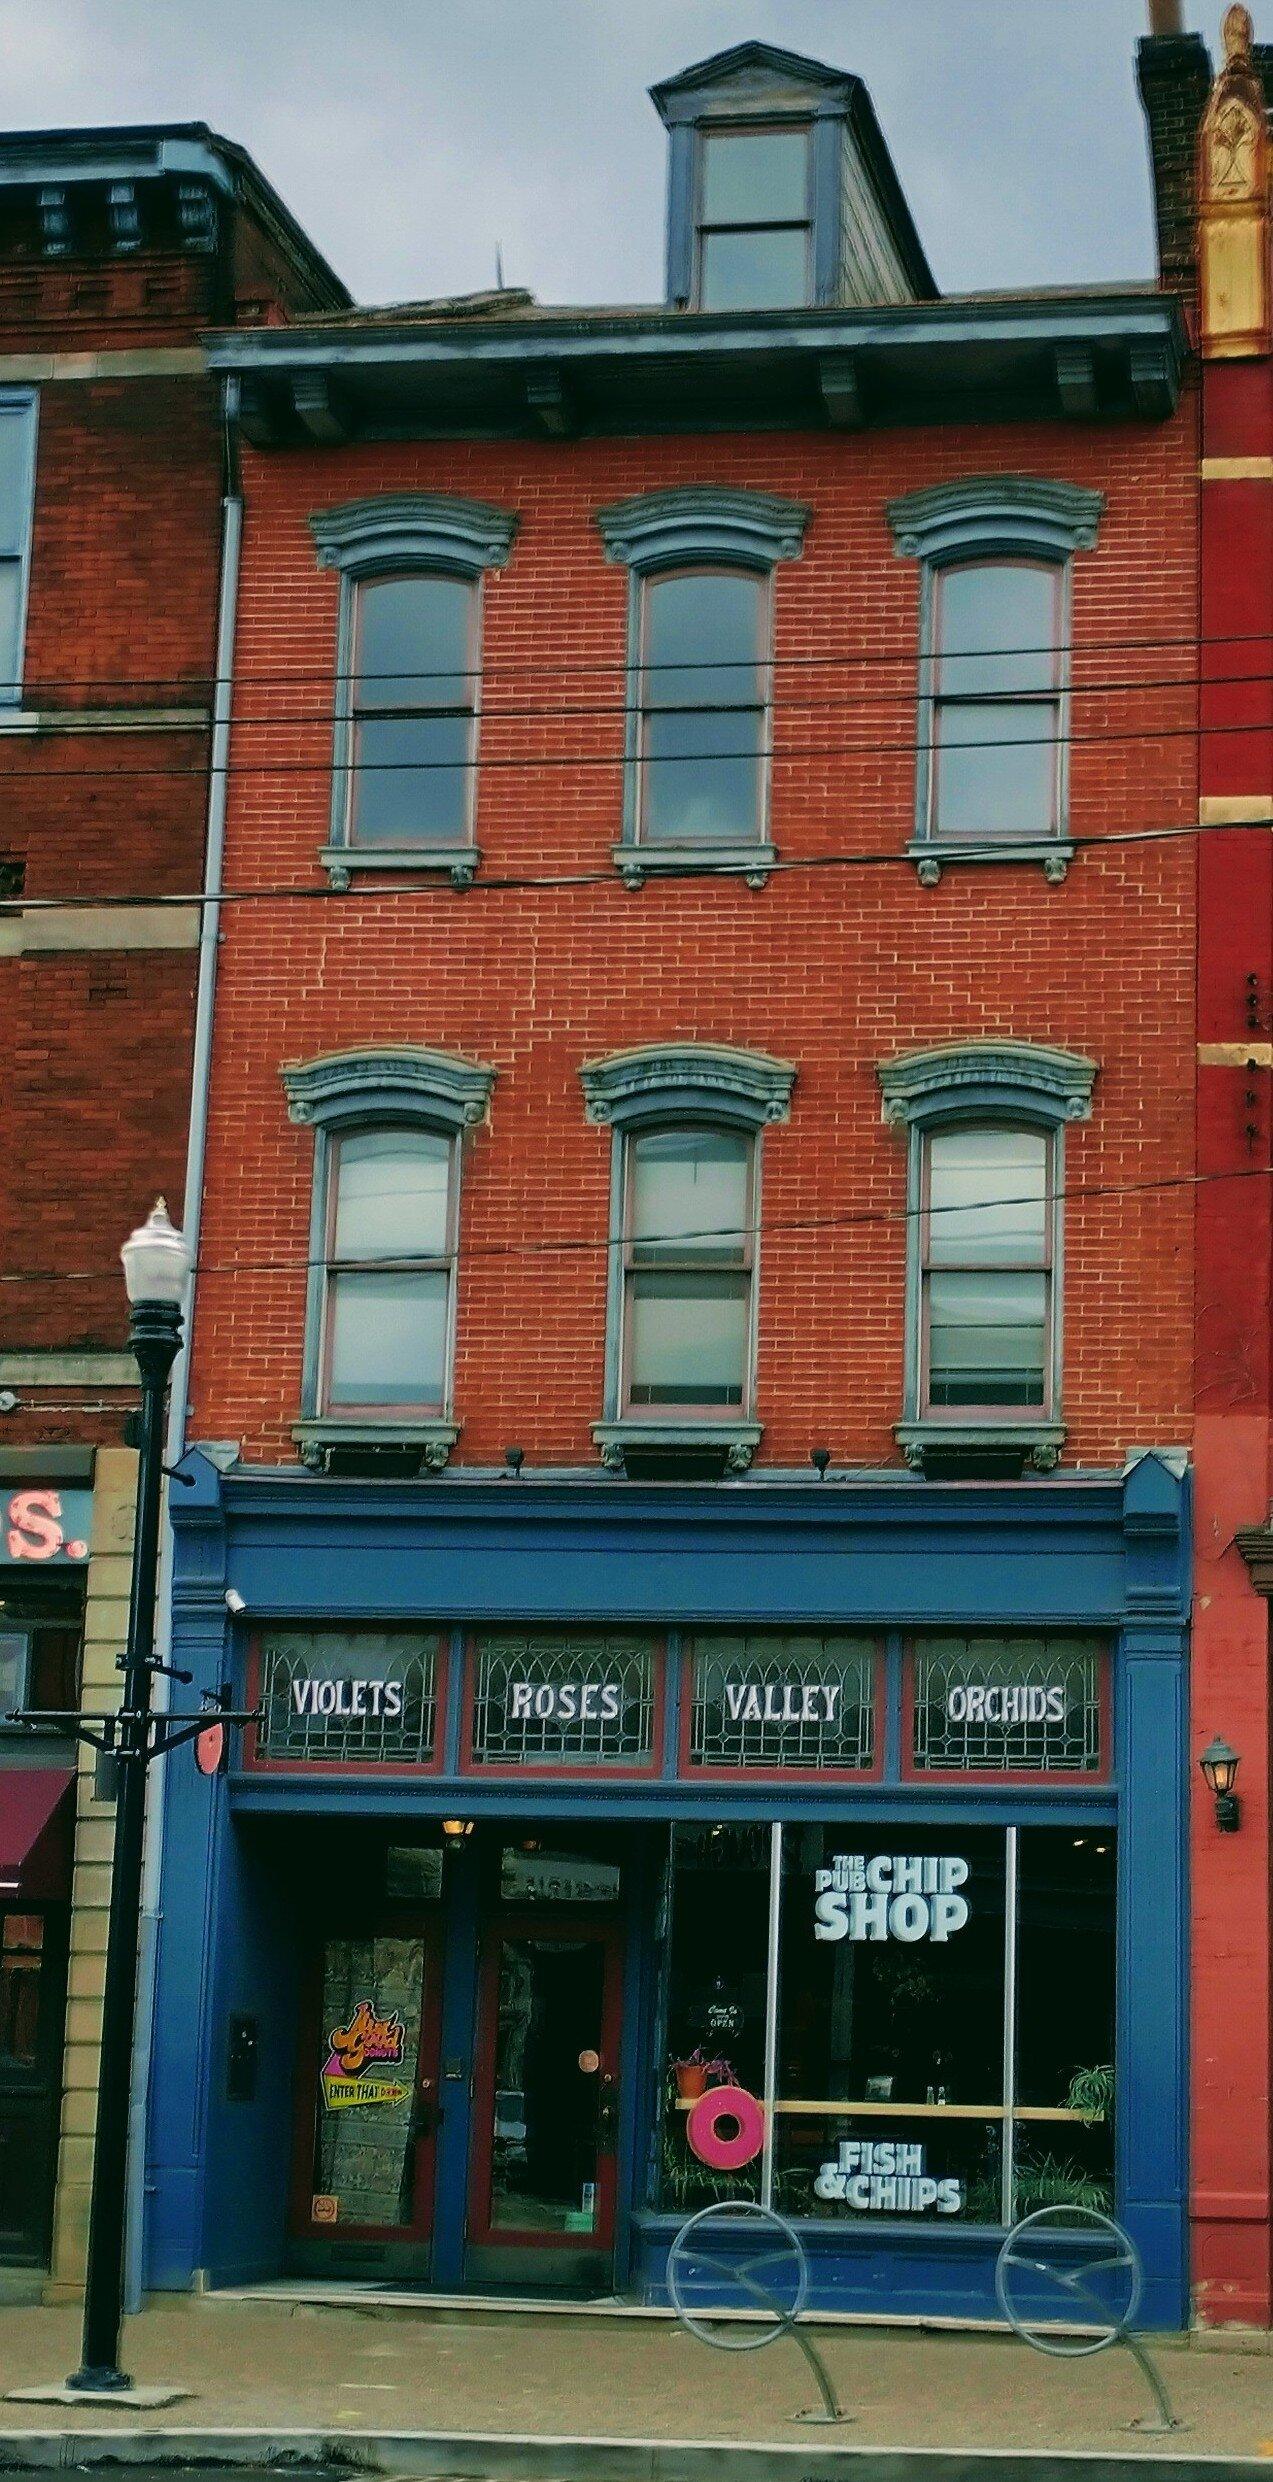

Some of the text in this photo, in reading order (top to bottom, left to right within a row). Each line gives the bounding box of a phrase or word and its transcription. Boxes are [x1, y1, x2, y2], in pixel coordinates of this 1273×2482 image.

[0, 1490, 88, 1559] S.
[293, 1680, 402, 1716] VIOLETS
[511, 1683, 621, 1719] ROSES
[725, 1685, 841, 1721] VALLEY
[948, 1686, 1065, 1722] ORCHIDS
[814, 1869, 866, 1893] PUB
[832, 1855, 865, 1871] THE
[866, 1856, 969, 1894] CHIP
[814, 1891, 969, 1942] SHOP
[330, 2084, 355, 2098] ENTER
[357, 2084, 379, 2099] THAT
[838, 2142, 923, 2176] FISH
[814, 2162, 961, 2213] & CHIPS
